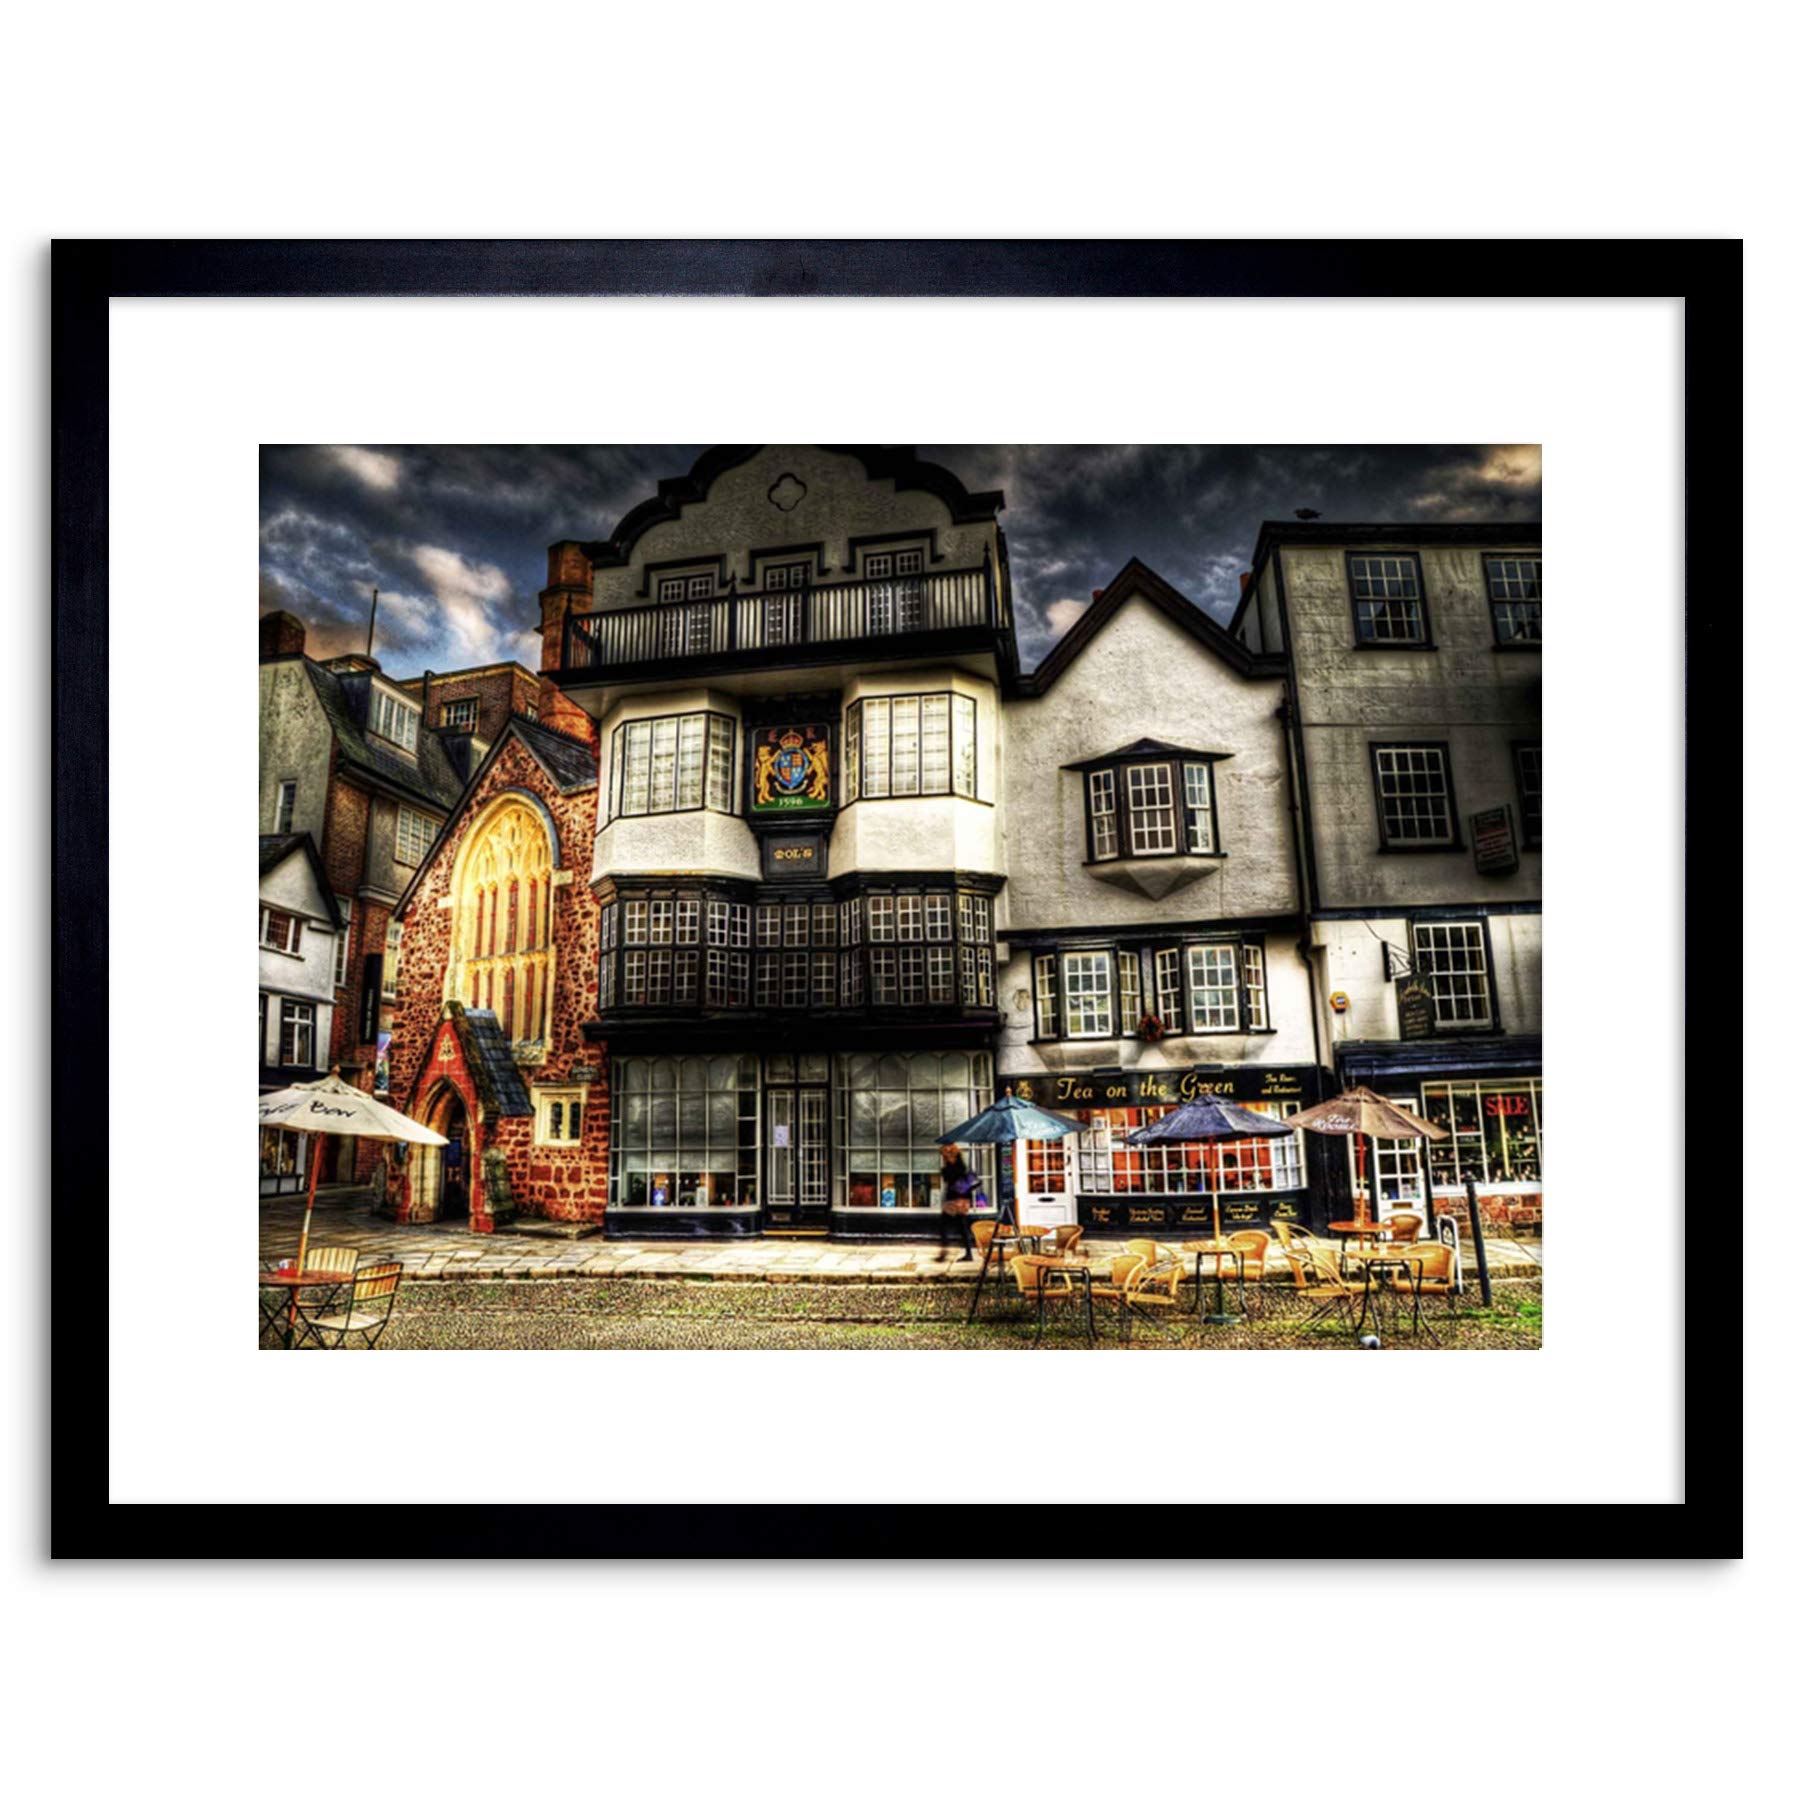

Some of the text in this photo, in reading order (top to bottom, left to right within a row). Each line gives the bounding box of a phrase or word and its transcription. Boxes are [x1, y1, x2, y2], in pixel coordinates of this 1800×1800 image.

[1057, 1072, 1234, 1103] Tea on the Green
[1485, 1096, 1530, 1116] SALE
